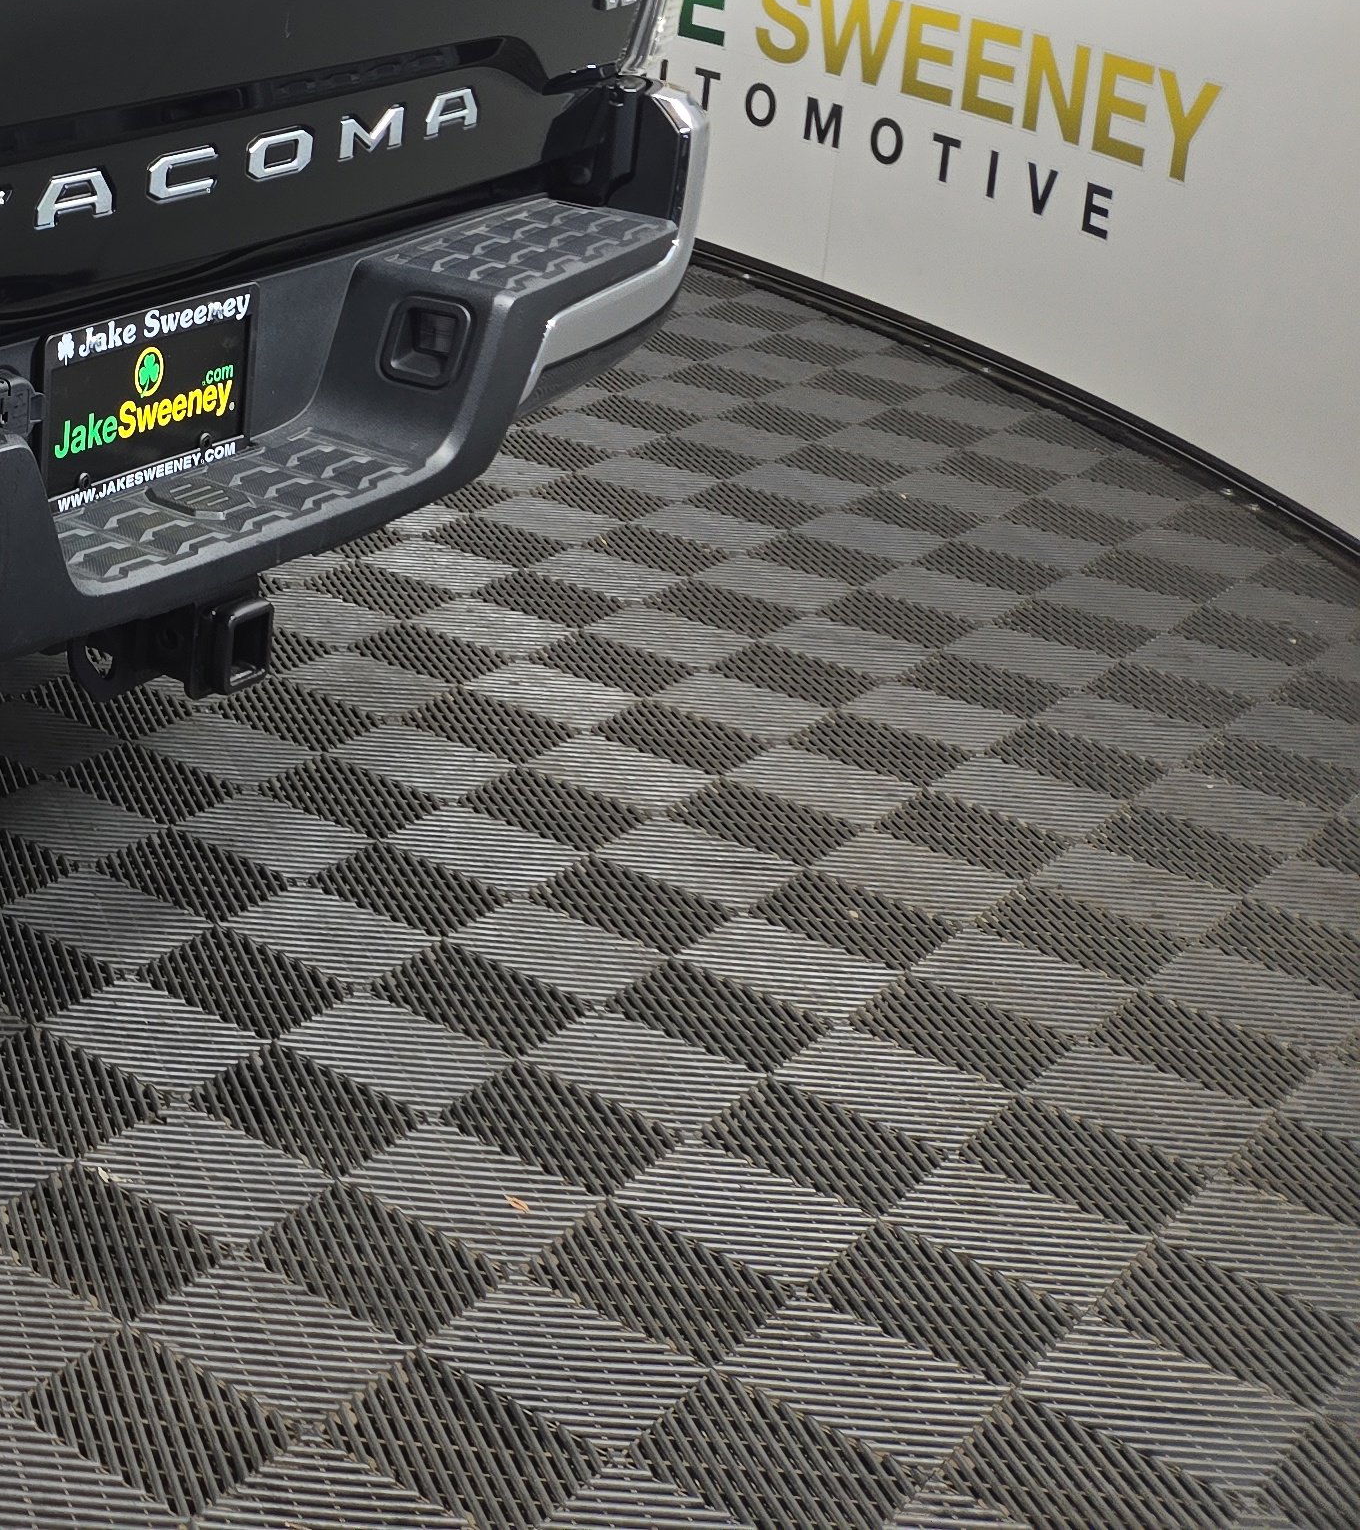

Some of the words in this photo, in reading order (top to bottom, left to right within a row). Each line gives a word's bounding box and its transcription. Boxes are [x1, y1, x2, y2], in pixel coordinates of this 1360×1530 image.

[660, 58, 1113, 240] TOMOTIVE
[79, 320, 136, 357] Jake
[143, 294, 251, 338] Sweeney
[202, 363, 234, 387] .com
[57, 442, 236, 513] WWW.JAKESWEENEY.COM
